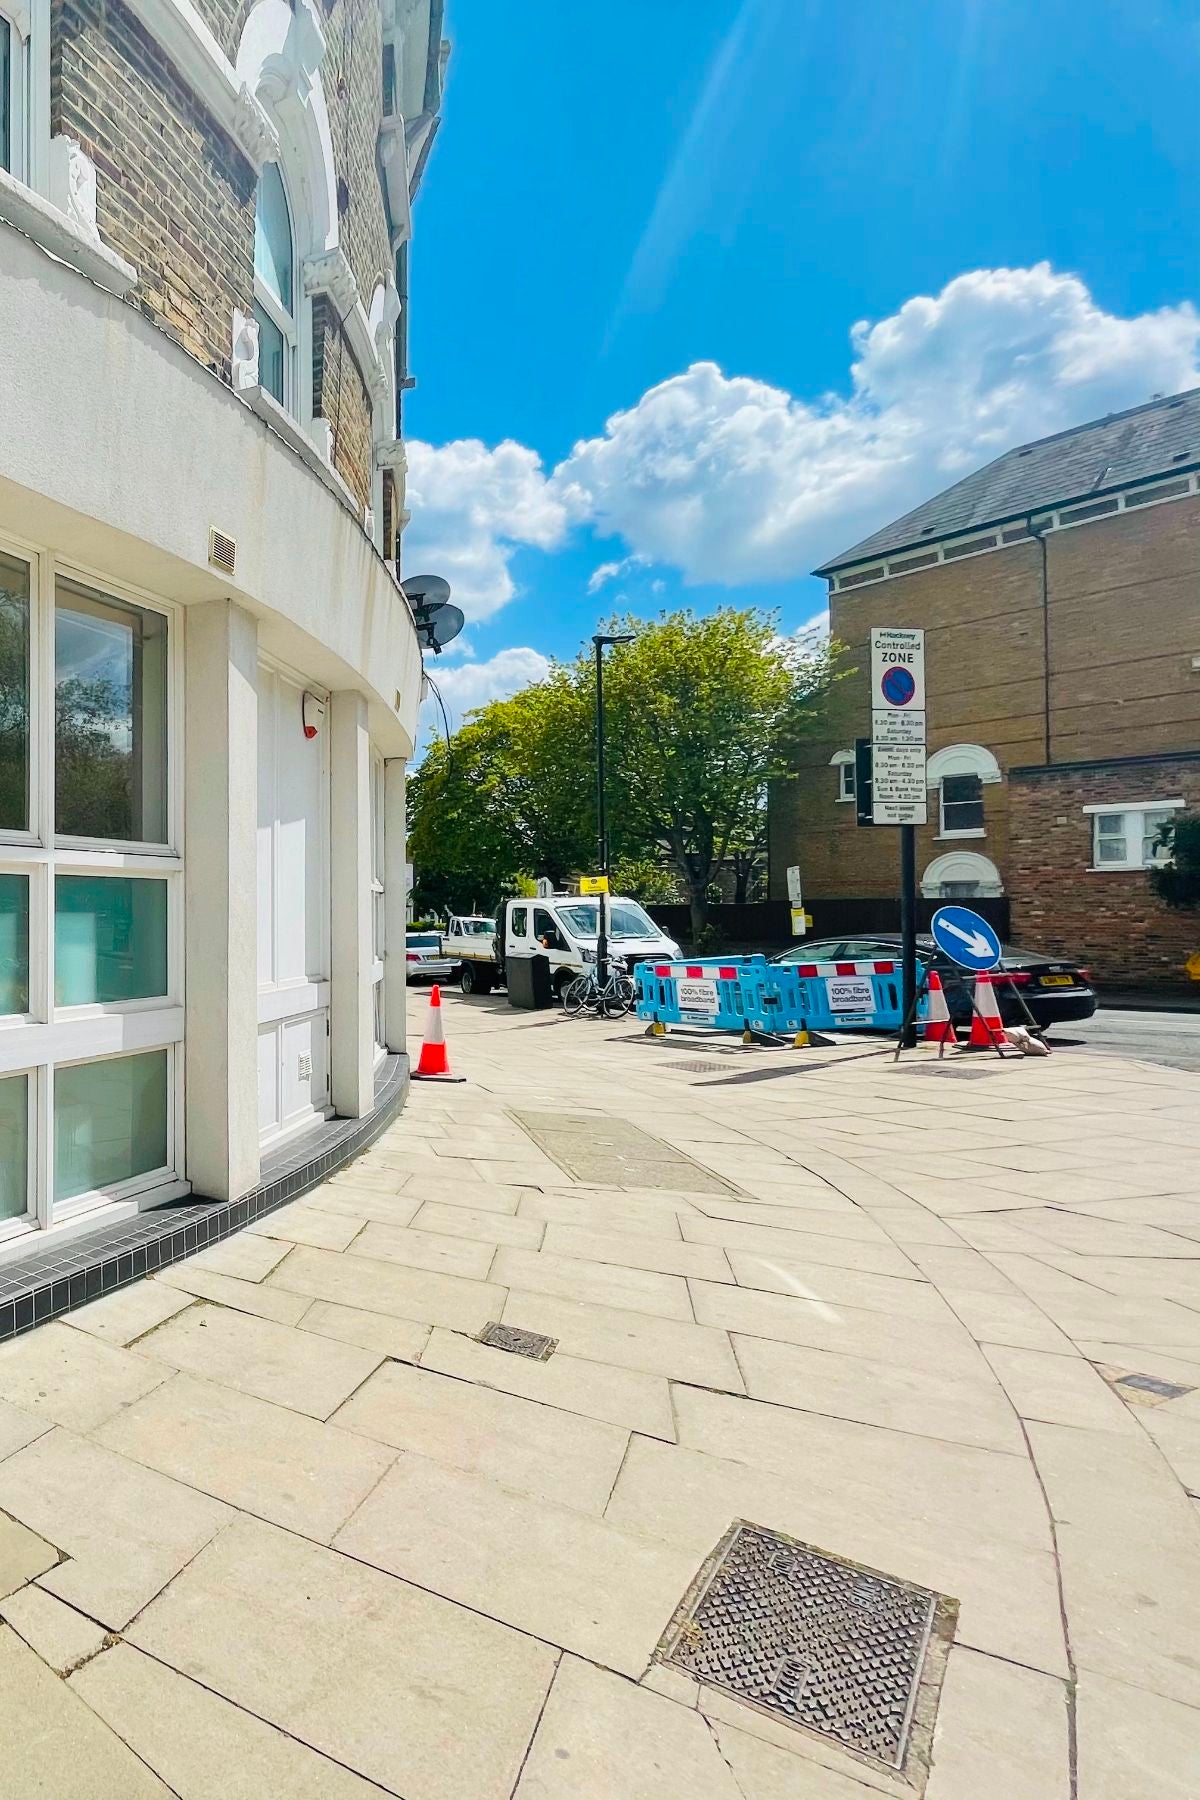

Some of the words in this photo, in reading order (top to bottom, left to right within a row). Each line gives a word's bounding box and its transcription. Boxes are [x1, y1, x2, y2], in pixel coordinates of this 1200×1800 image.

[874, 640, 920, 650] Controlled
[882, 652, 914, 663] ZONE
[832, 987, 852, 995] 100%
[832, 994, 872, 1003] broadband
